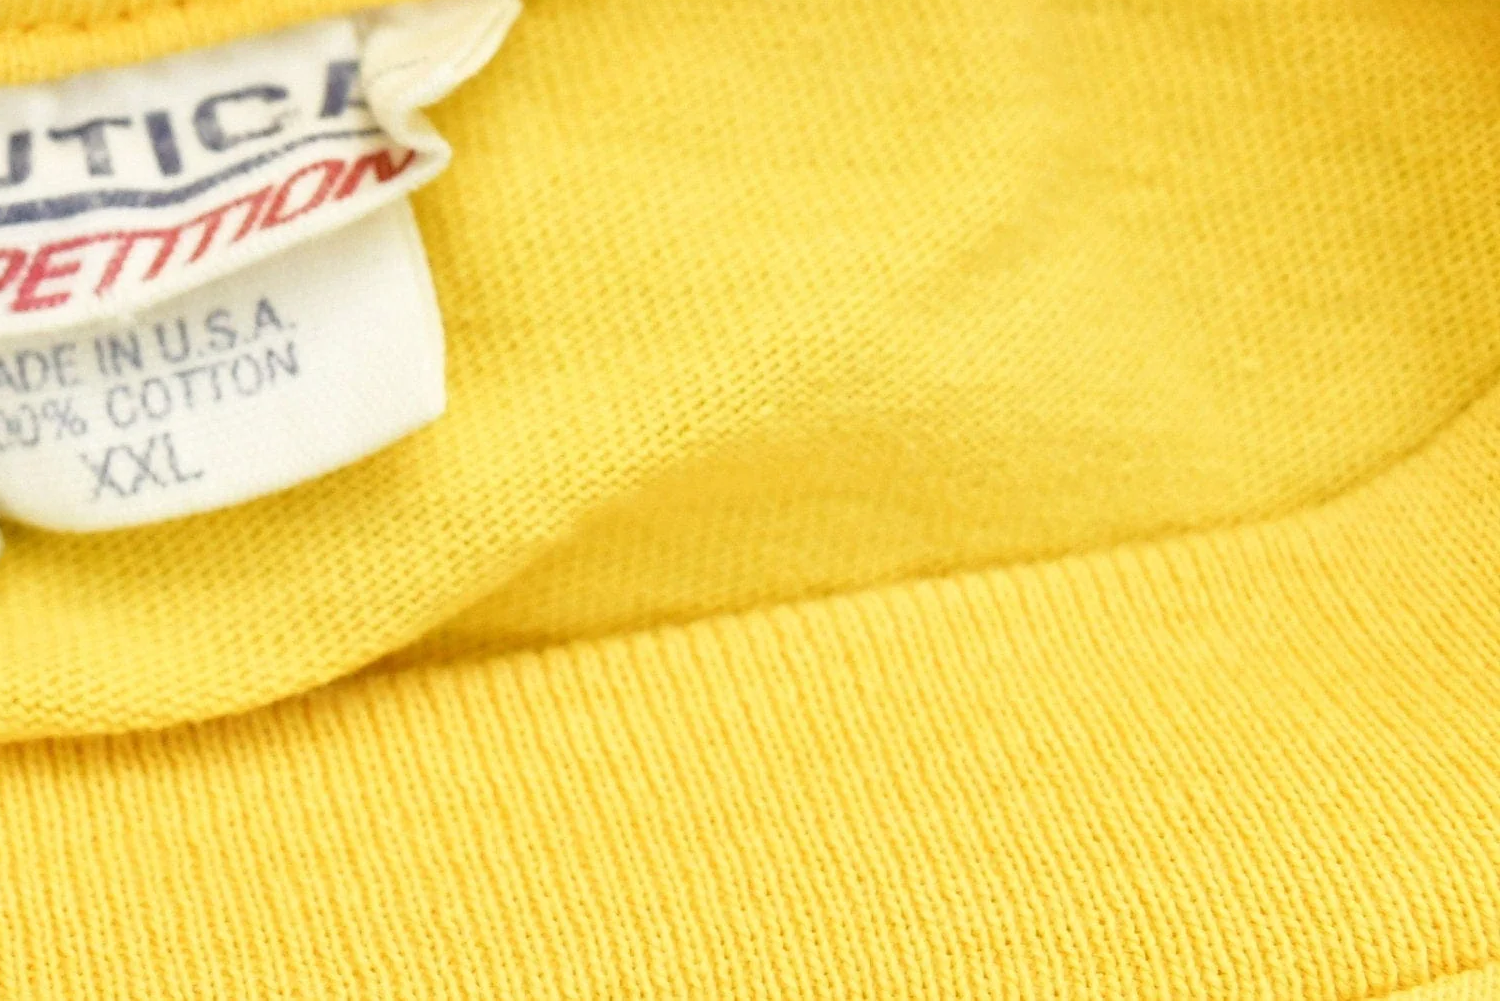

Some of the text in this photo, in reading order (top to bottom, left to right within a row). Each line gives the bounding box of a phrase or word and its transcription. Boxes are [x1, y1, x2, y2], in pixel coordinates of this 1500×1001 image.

[93, 327, 145, 378] IN
[153, 295, 299, 367] U.S.A.
[105, 340, 300, 430] COTTON
[77, 431, 205, 501] XXL
